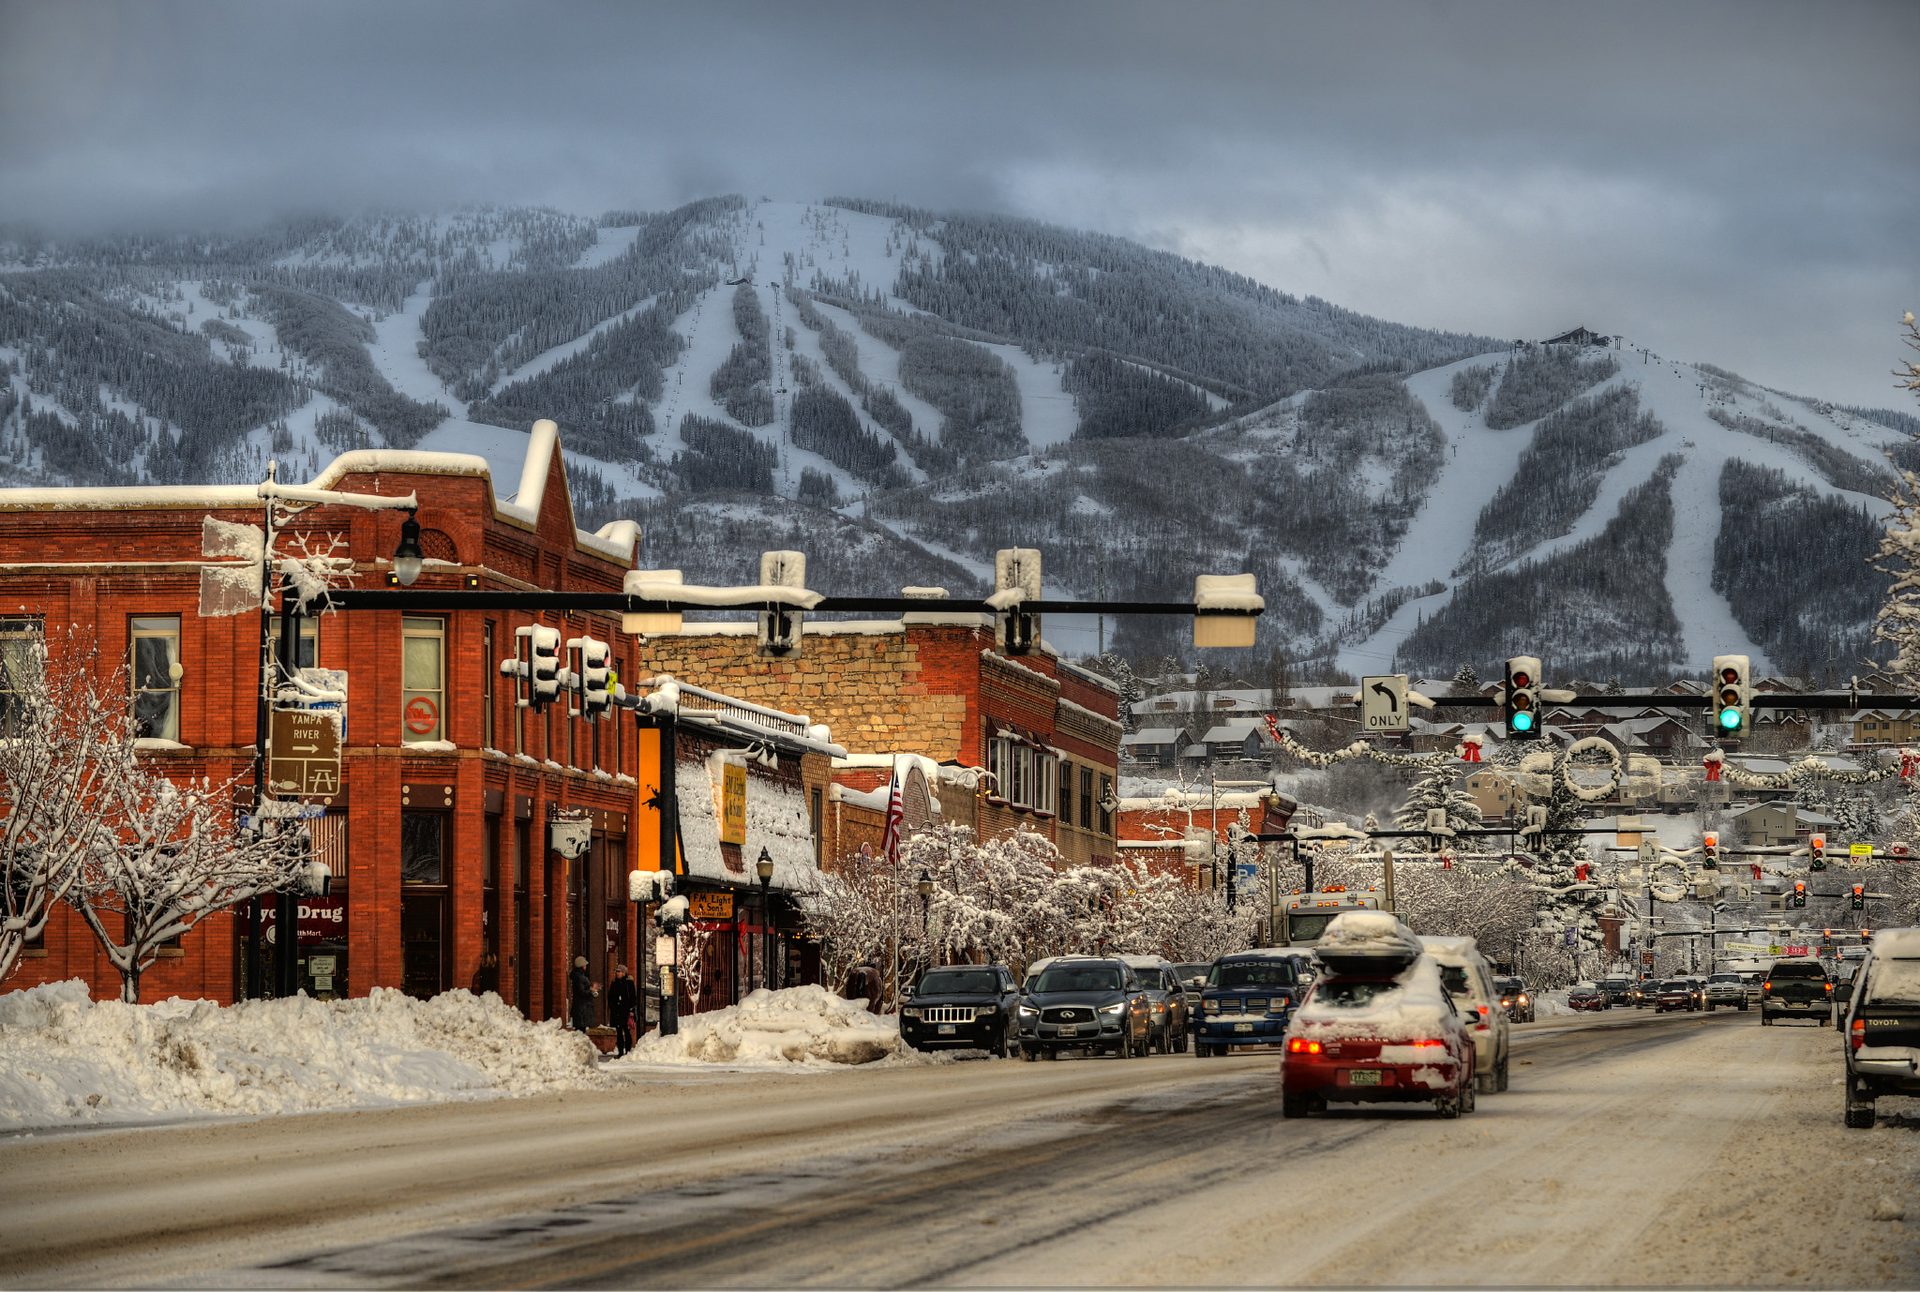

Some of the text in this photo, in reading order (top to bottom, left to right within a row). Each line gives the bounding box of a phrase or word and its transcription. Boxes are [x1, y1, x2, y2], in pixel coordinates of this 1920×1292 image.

[292, 714, 322, 725] YAMPA
[1370, 715, 1402, 726] ONLY
[293, 729, 320, 739] RIVER
[711, 894, 731, 906] Light
[707, 902, 724, 912] Sons
[297, 905, 343, 922] Drug
[1222, 961, 1282, 969] DODGE
